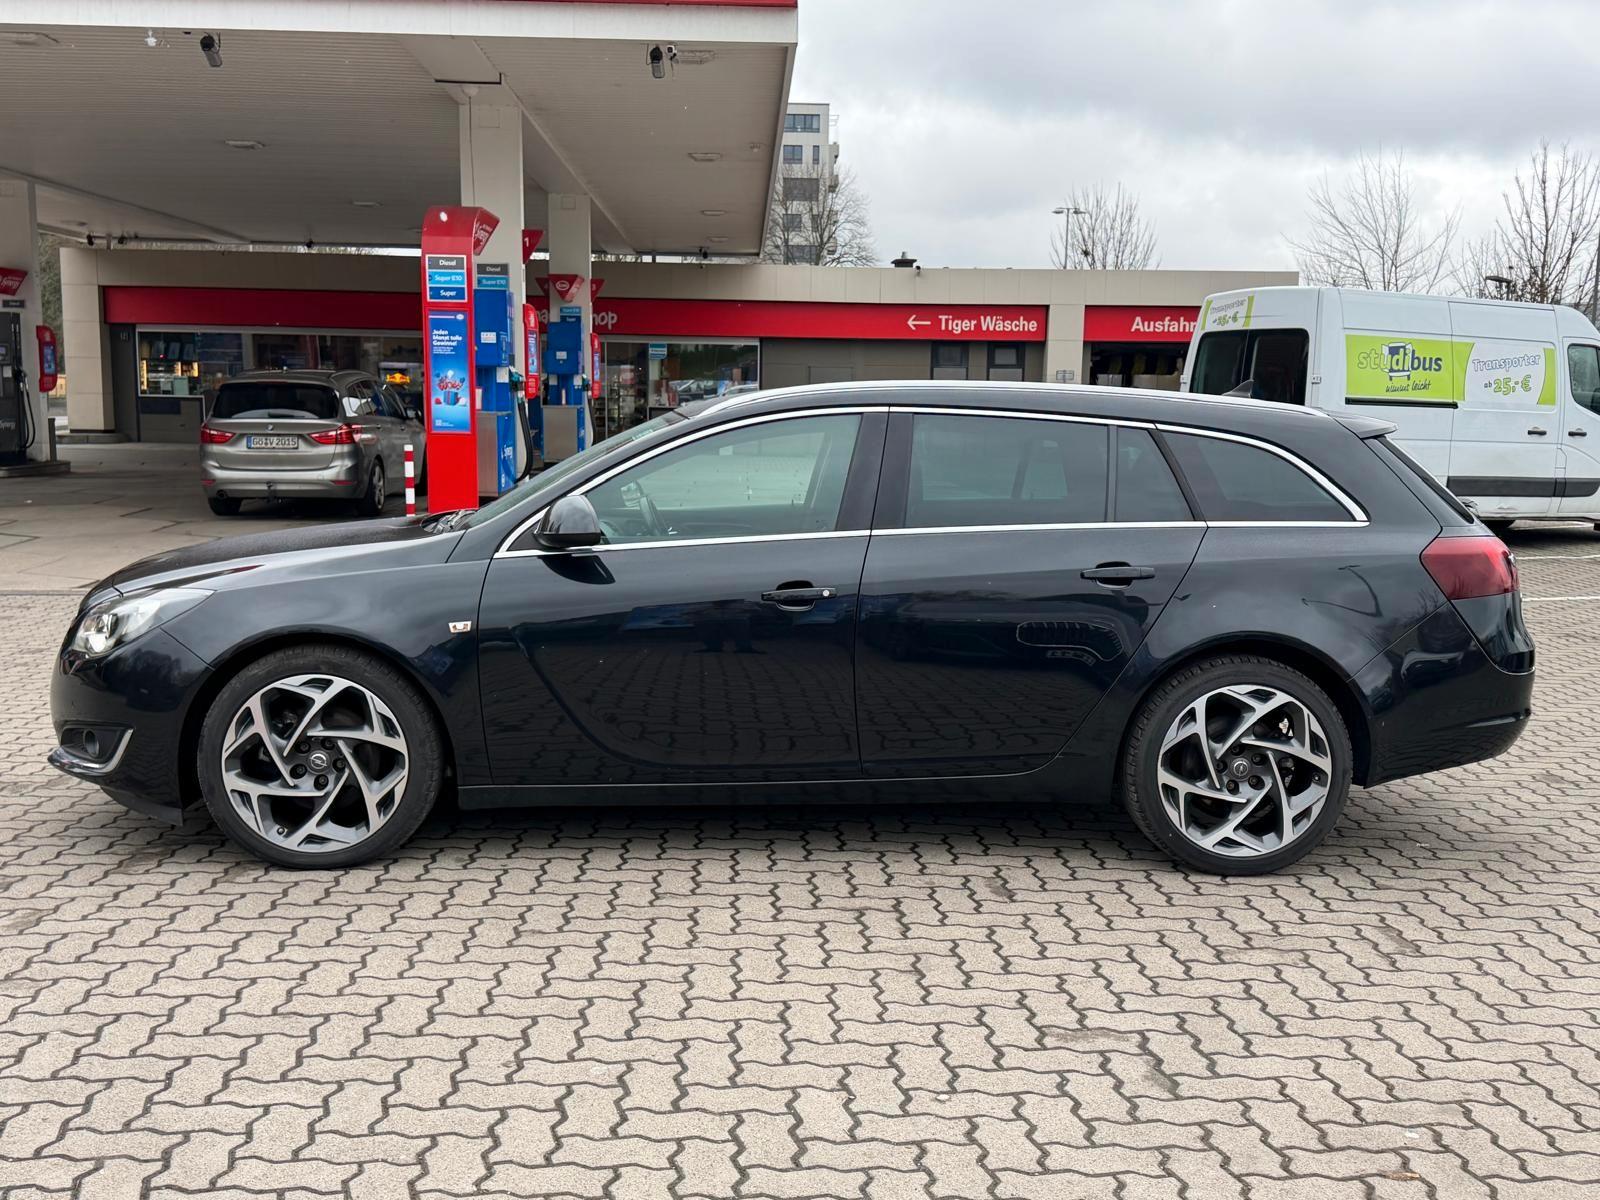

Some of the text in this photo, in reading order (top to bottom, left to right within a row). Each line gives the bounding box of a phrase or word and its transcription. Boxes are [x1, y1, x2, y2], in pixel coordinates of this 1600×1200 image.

[434, 274, 450, 282] Super
[440, 289, 457, 297] Super
[938, 315, 1038, 334] Tiger Wäsche
[1131, 316, 1197, 332] Ausfahr
[1357, 348, 1443, 372] studibus
[1472, 354, 1541, 372] Transporter
[1412, 378, 1432, 391] leicht
[276, 437, 297, 446] 2015
